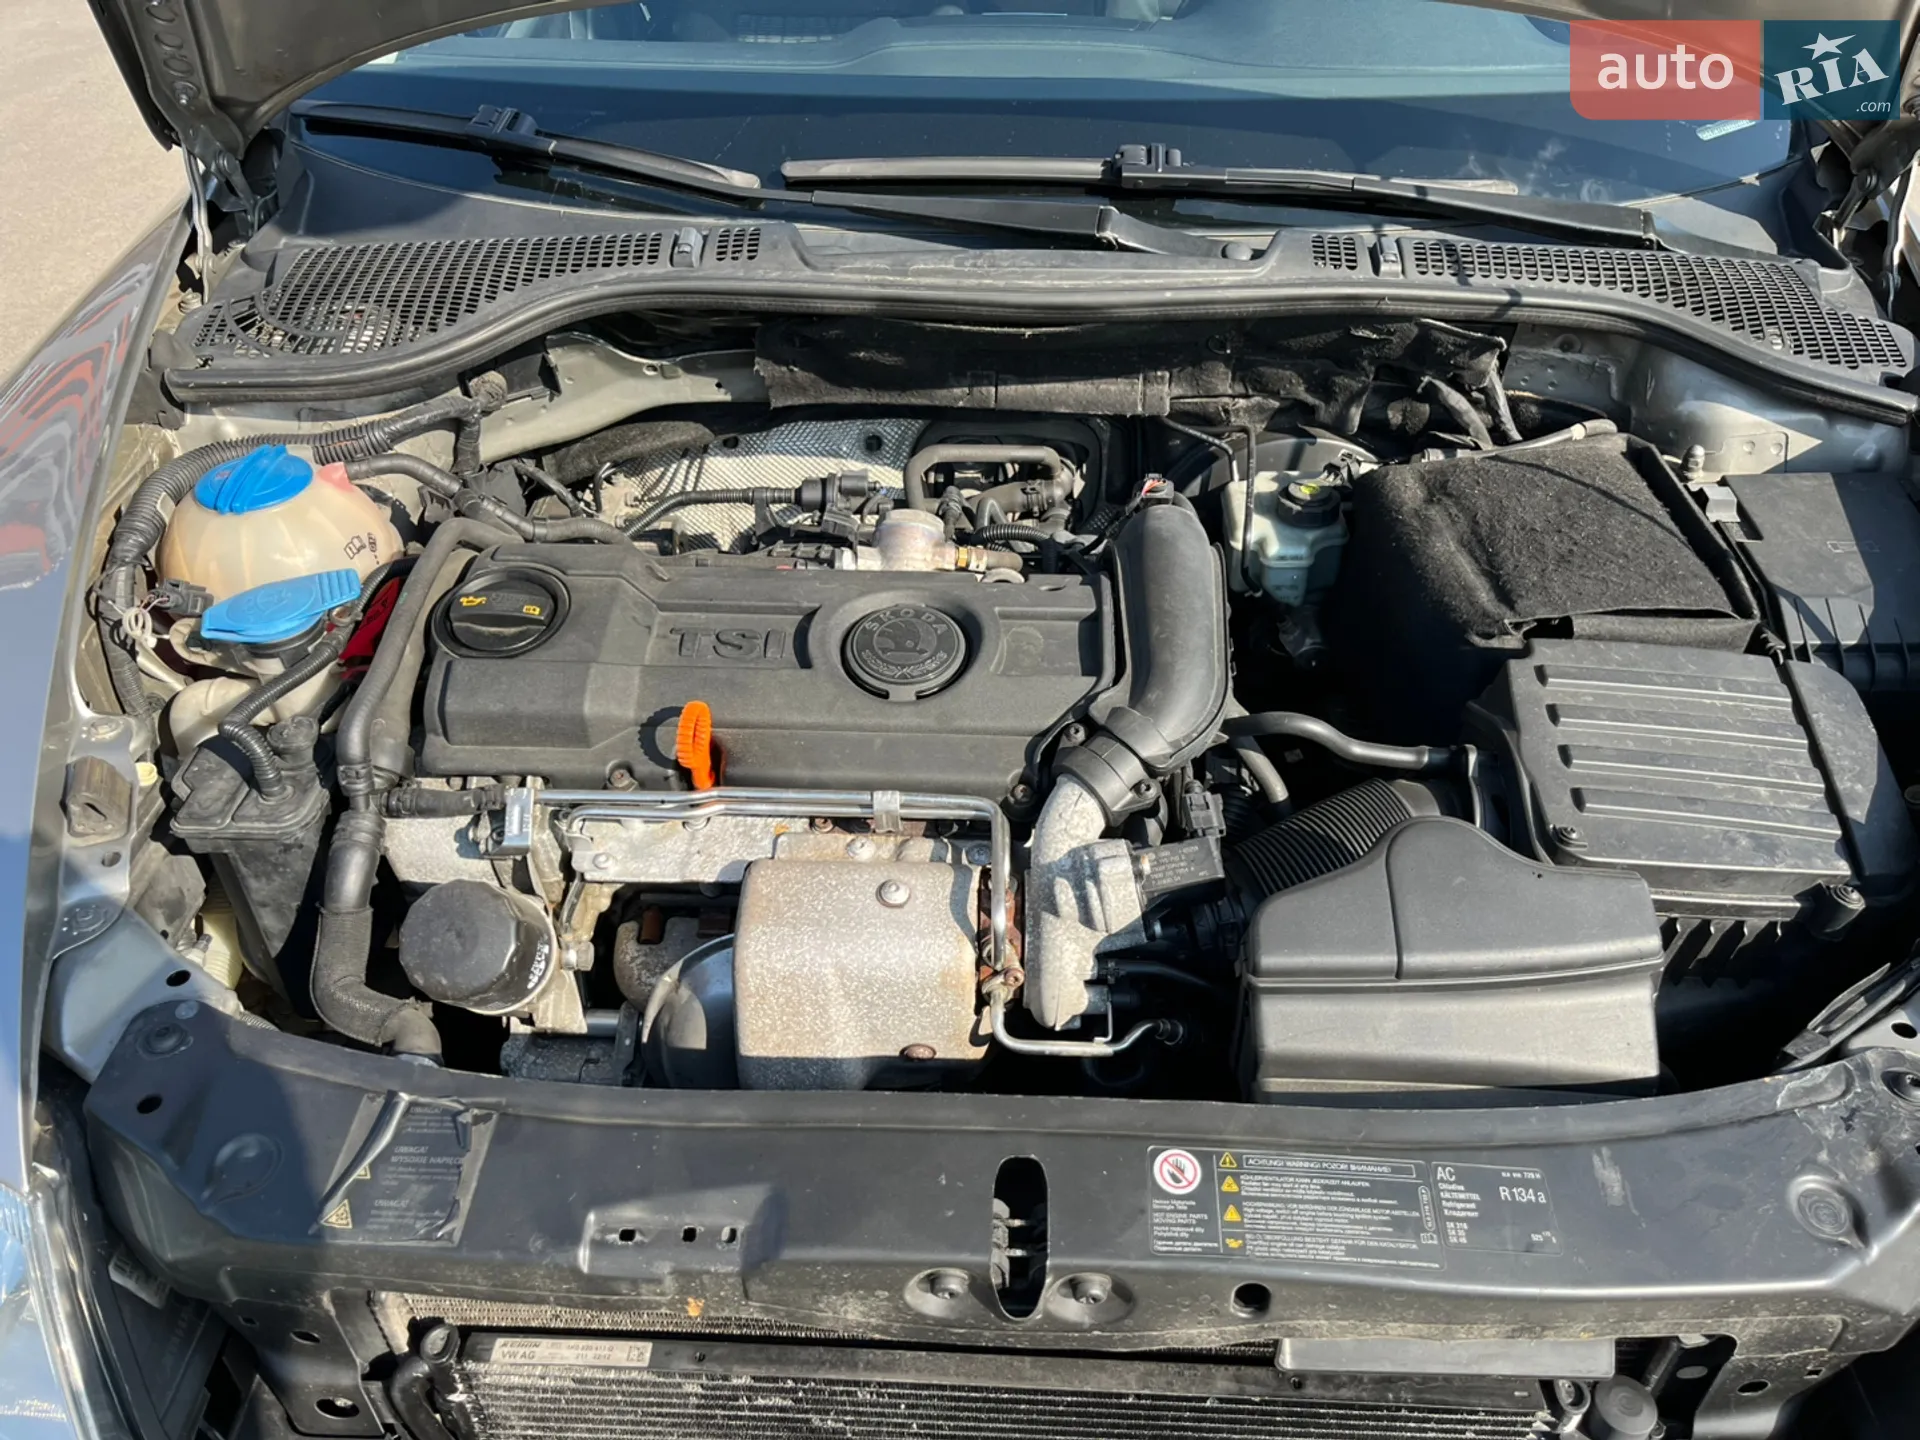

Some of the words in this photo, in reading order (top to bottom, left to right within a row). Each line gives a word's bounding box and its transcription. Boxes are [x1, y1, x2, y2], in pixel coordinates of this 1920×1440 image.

[669, 627, 787, 659] TSI
[1436, 1166, 1456, 1181] AC
[502, 1351, 518, 1359] VW
[520, 1351, 536, 1360] AG
